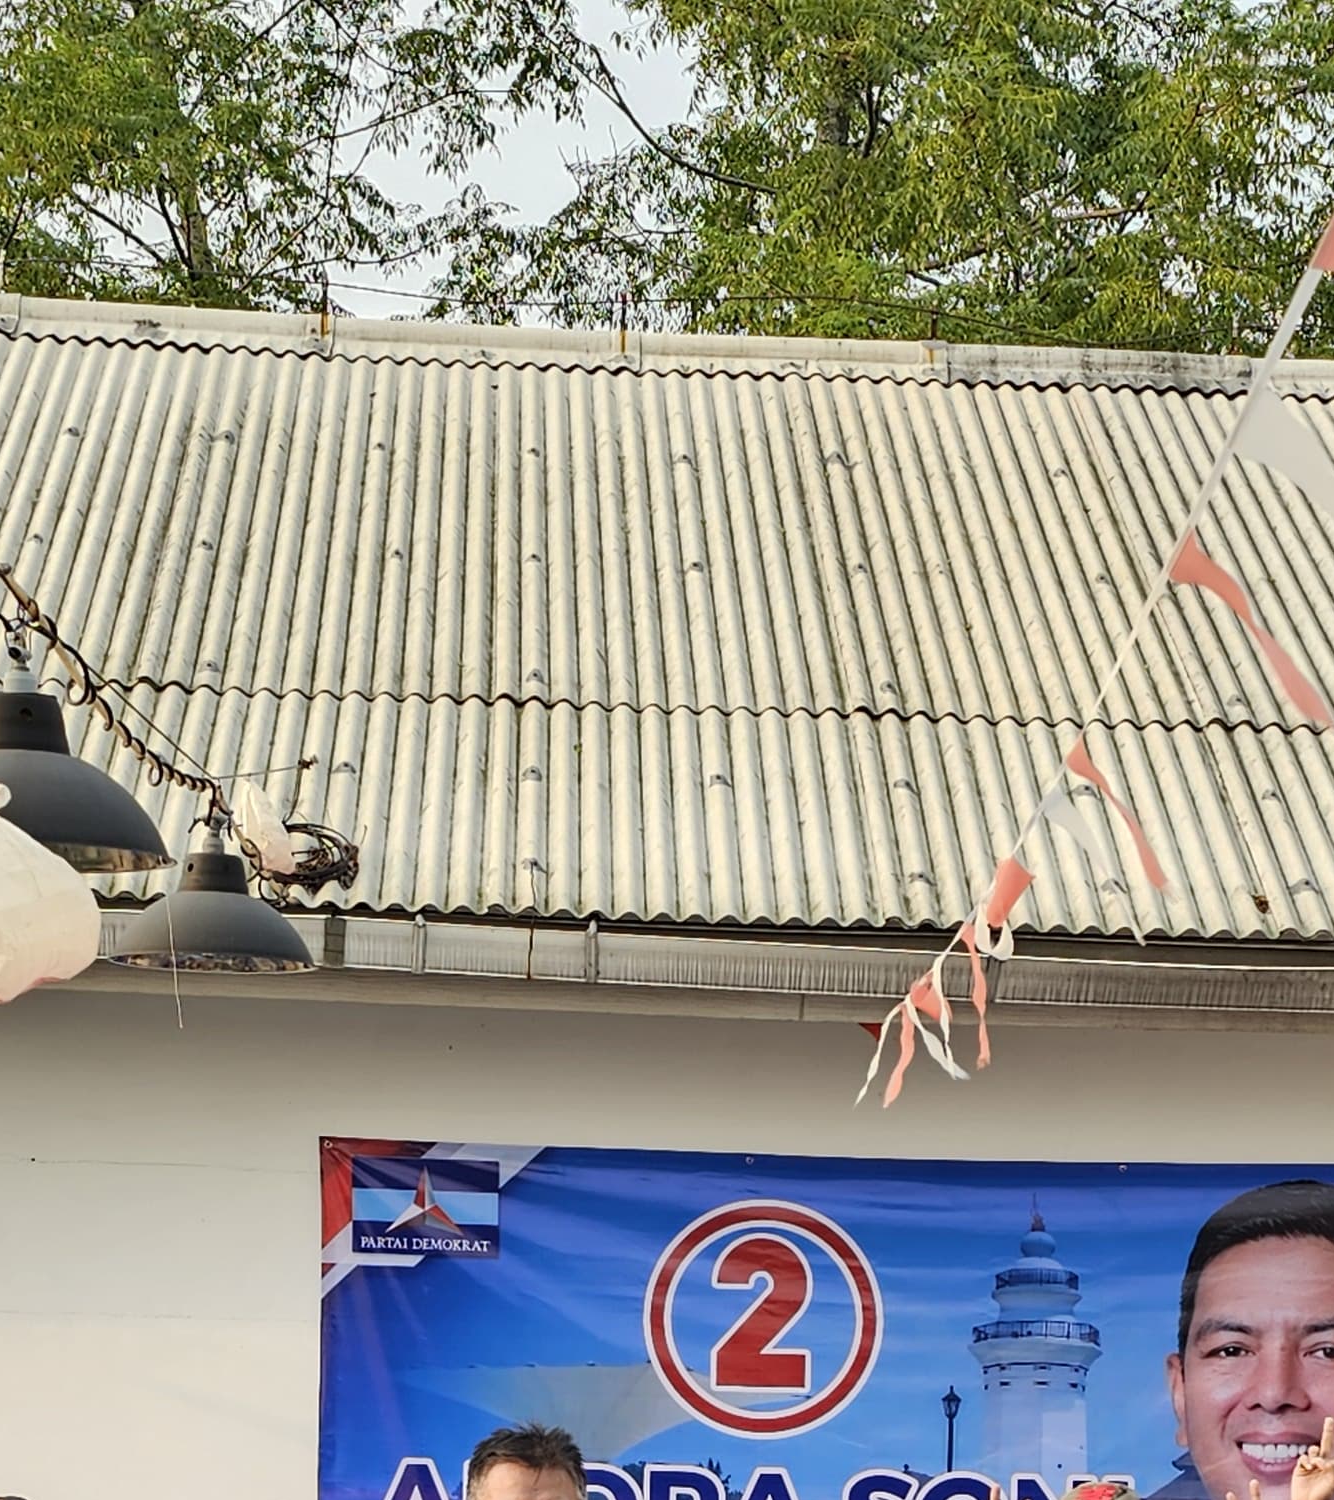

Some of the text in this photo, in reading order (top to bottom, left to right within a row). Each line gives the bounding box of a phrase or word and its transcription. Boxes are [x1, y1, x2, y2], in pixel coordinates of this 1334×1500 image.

[360, 1235, 491, 1253] PARTAI DEMOKRAT
[713, 1233, 813, 1392] 2
